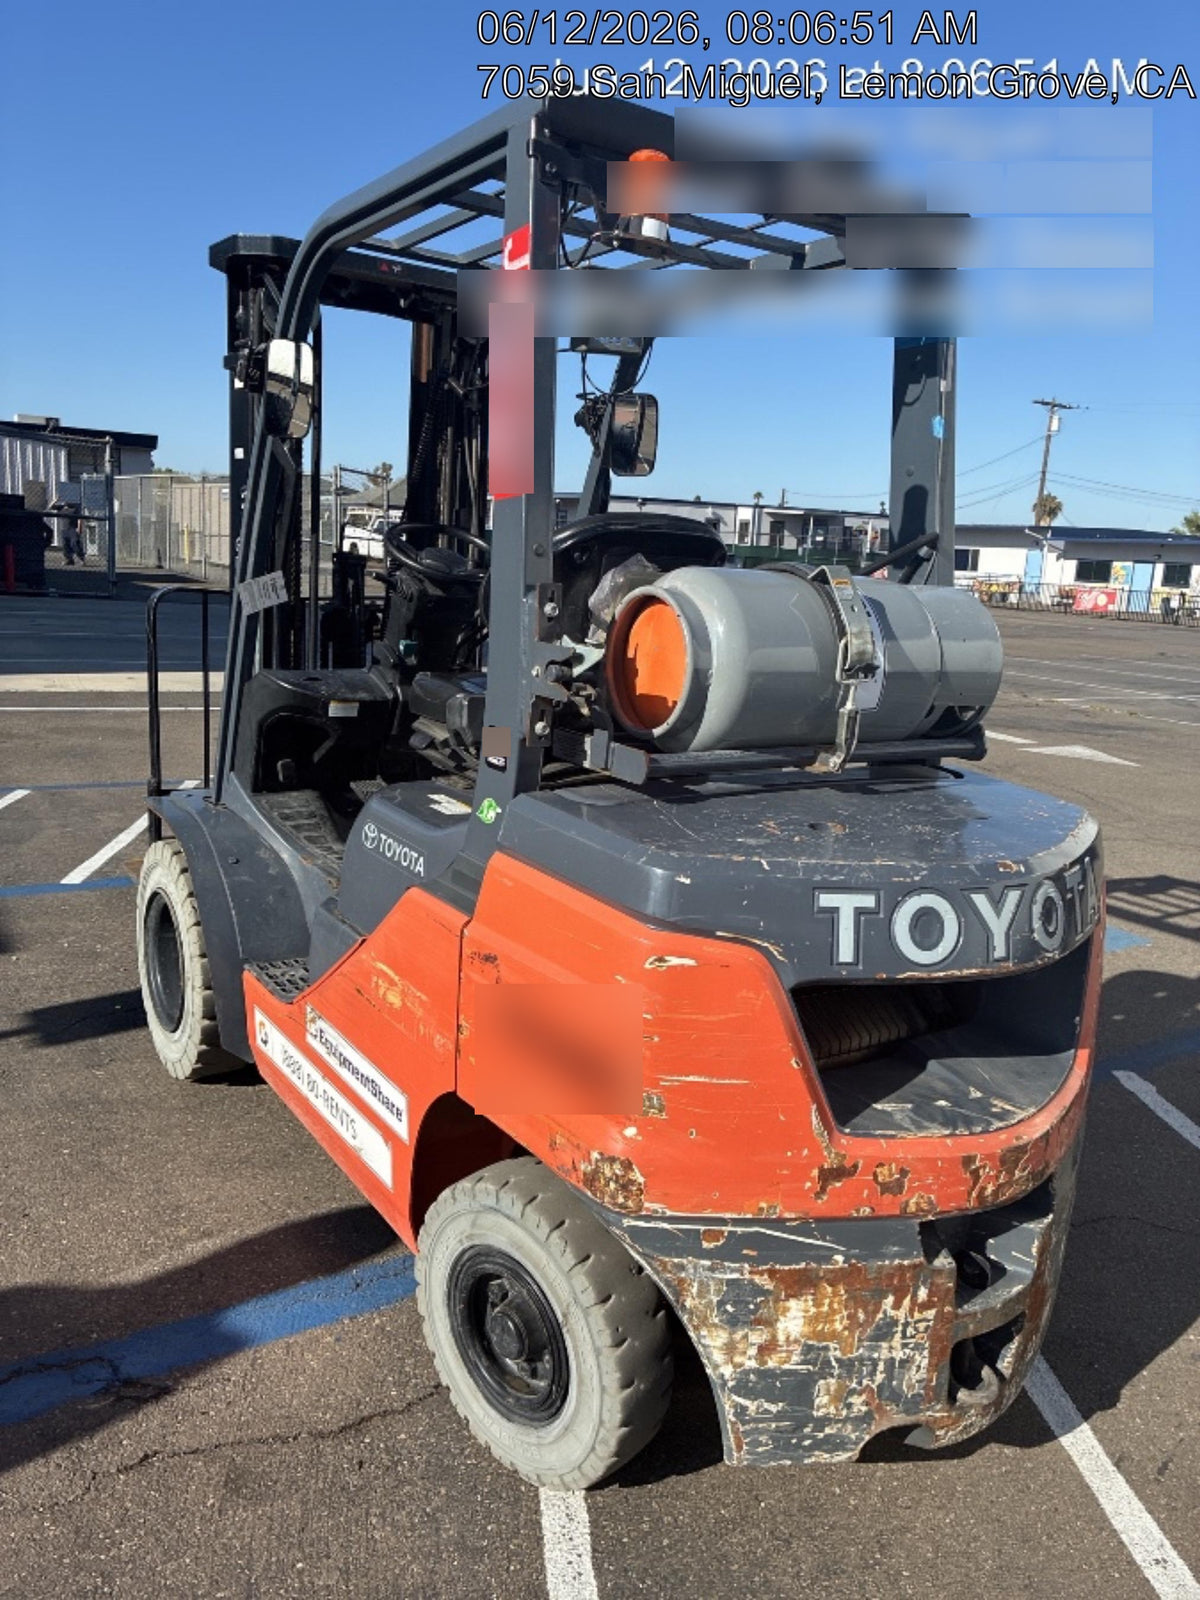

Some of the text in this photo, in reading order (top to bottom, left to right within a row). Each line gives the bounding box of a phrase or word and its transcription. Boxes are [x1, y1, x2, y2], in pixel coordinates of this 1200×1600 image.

[380, 833, 424, 877] TOYOTA
[815, 856, 1099, 966] TOYOTA
[318, 1028, 404, 1123] EquipmentShare
